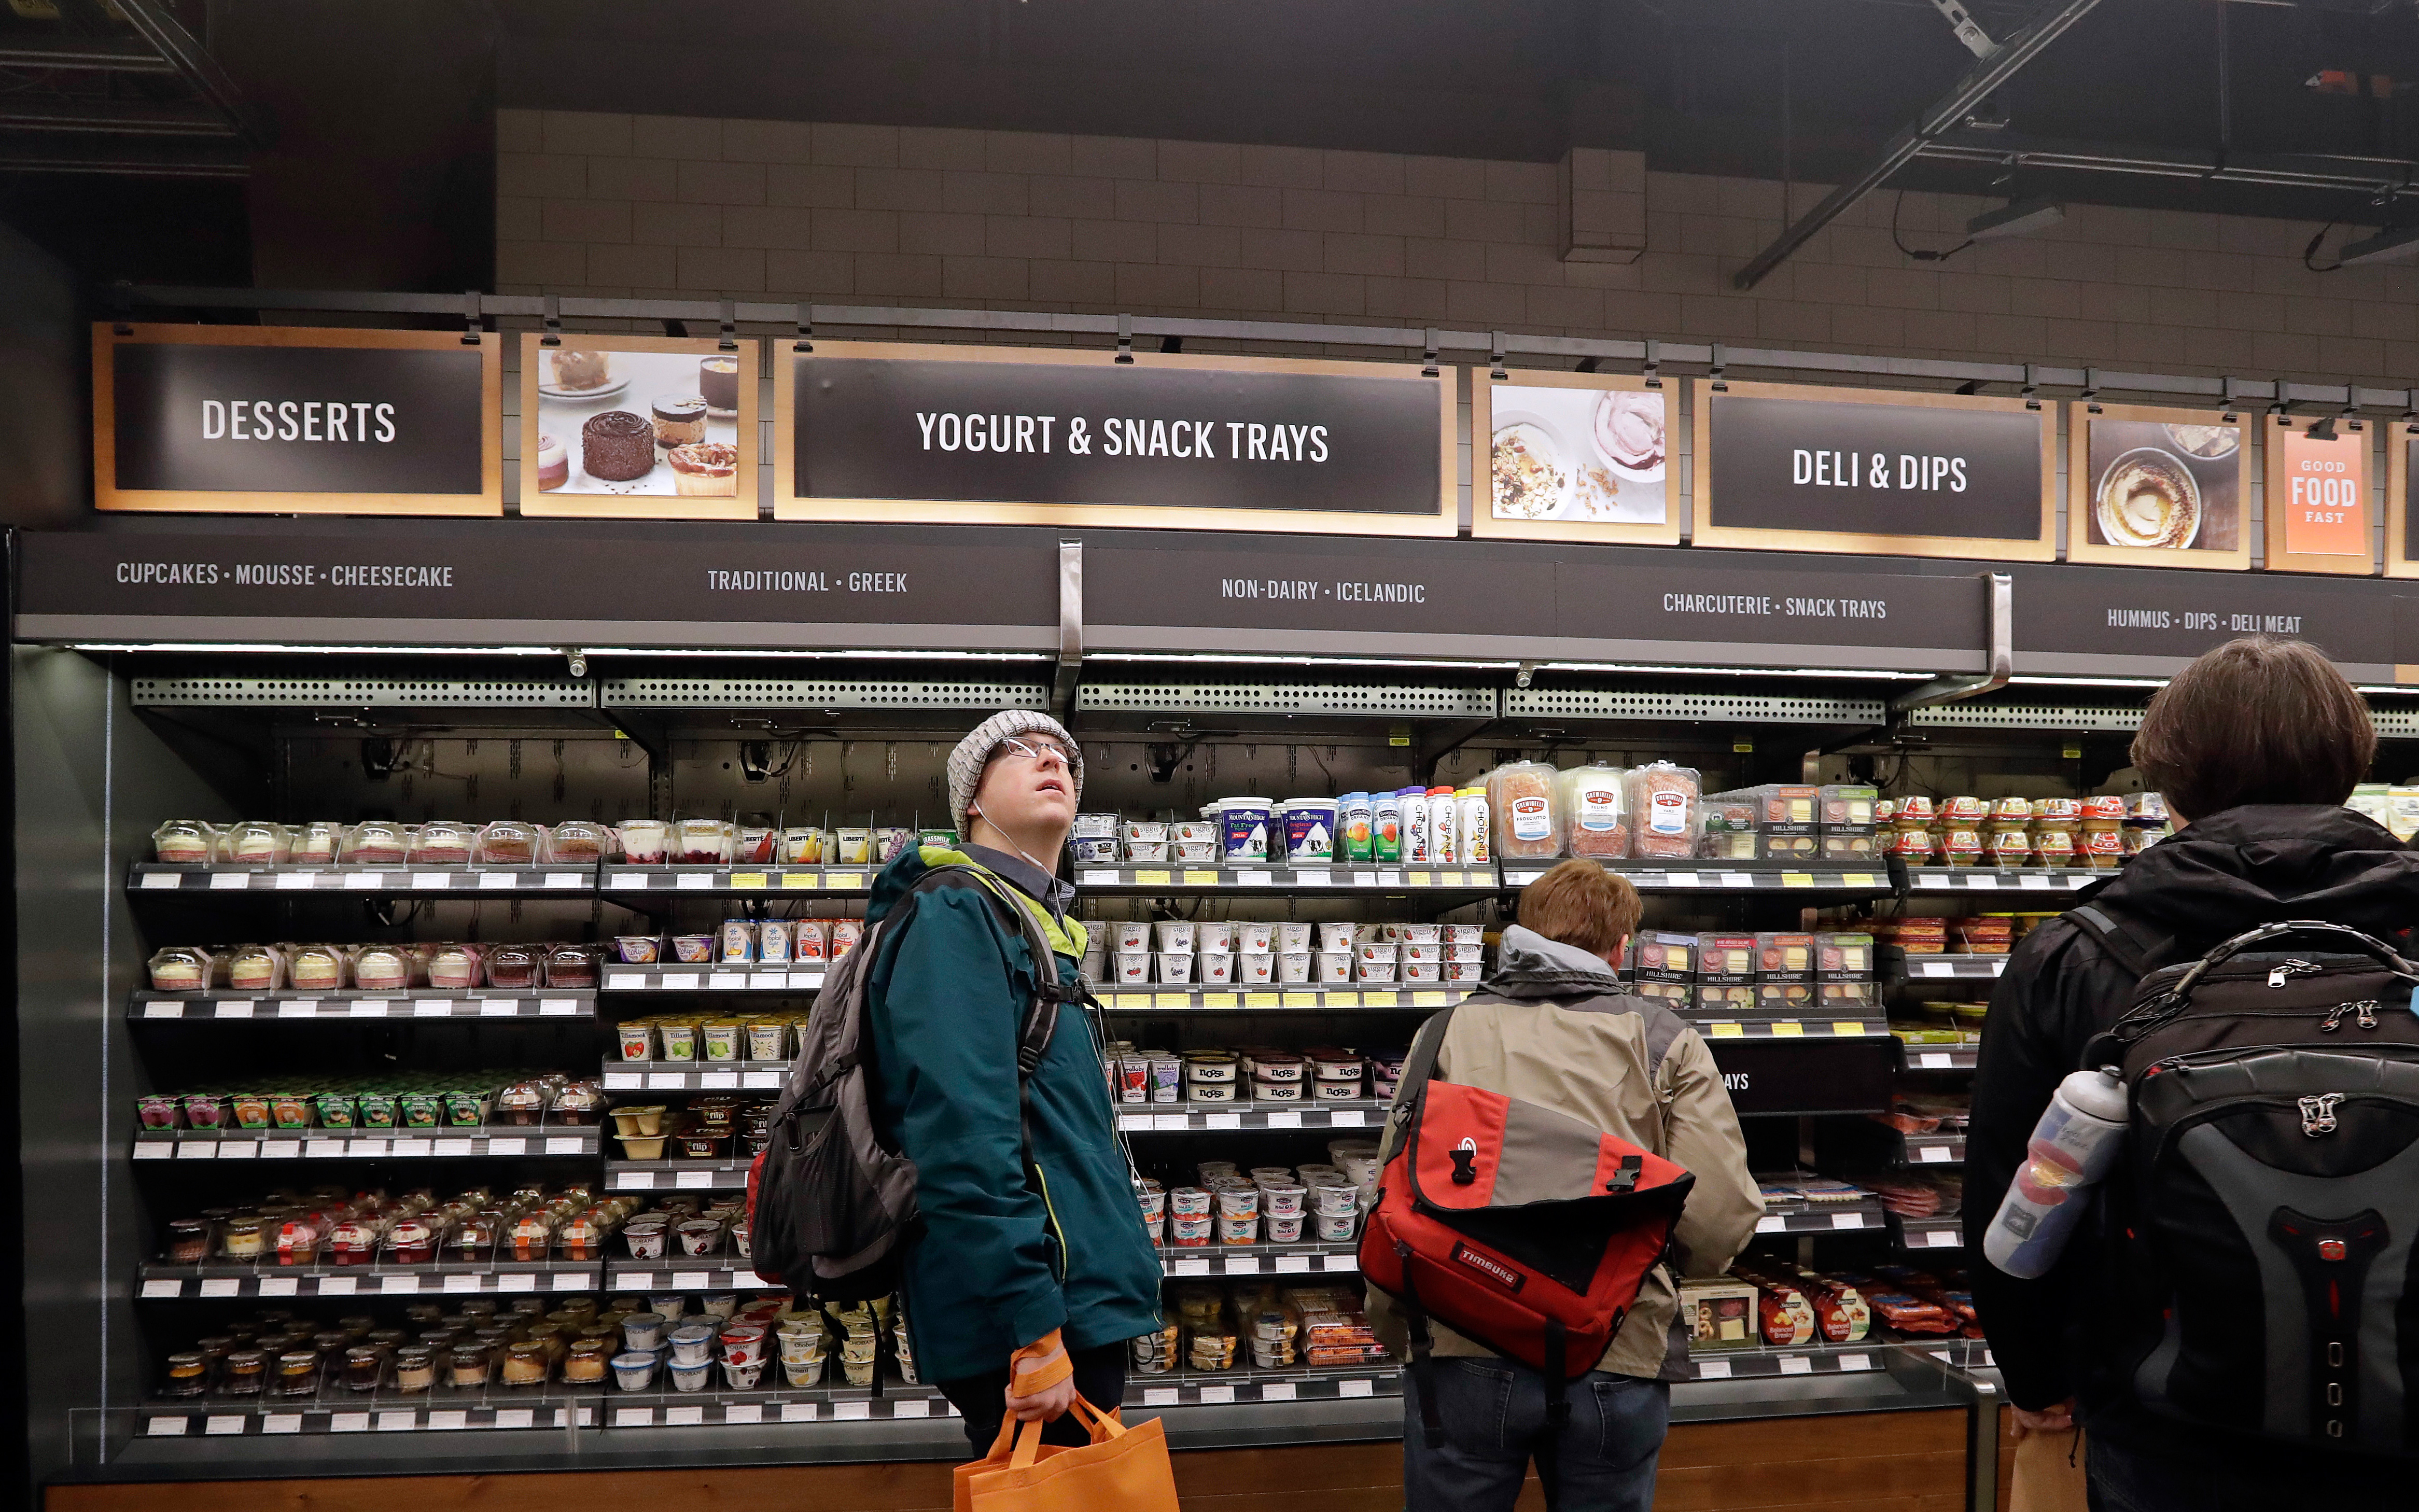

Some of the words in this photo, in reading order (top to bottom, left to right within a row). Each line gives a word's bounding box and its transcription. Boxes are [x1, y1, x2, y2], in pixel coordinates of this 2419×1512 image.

[203, 400, 396, 442] DESSERTS
[917, 413, 1055, 453] YOGURT
[1068, 417, 1092, 455] &
[1103, 417, 1214, 458] SNACK
[1227, 422, 1329, 463] TRAYS
[1793, 450, 1858, 487] DELI
[1870, 453, 1890, 488] &
[1900, 455, 1967, 493] DIPS
[2301, 460, 2345, 472] GOOD
[2291, 477, 2356, 507] FOOD
[2305, 512, 2345, 523] FAST
[116, 562, 218, 584] CUPCAKES
[235, 564, 315, 585] MOUSSE
[331, 566, 453, 586] CHEESECAKE
[708, 570, 829, 591] TRADITIONAL
[848, 572, 907, 592] GREEK
[1222, 579, 1318, 600] NON-DAIRY
[1336, 582, 1425, 603] ICELANDIC
[1663, 593, 1771, 614] CHARCUTERIE
[1786, 597, 1836, 618] SNACK
[1840, 599, 1886, 619] TRAYS
[2108, 609, 2170, 628] HUMMUS
[2185, 612, 2217, 631] DIPS
[2232, 614, 2260, 632] DELI
[2266, 615, 2301, 634] MEAT
[1646, 971, 1682, 979] HILLSHIRE
[1199, 1069, 1224, 1077] noosa
[1271, 1069, 1295, 1077] noosa
[1725, 1073, 1749, 1089] AYS
[1199, 1089, 1224, 1098] noosa
[1271, 1089, 1295, 1097] noosa
[710, 1112, 724, 1120] flip
[692, 1142, 707, 1151] flip
[1462, 1250, 1514, 1283] TIMBUK2
